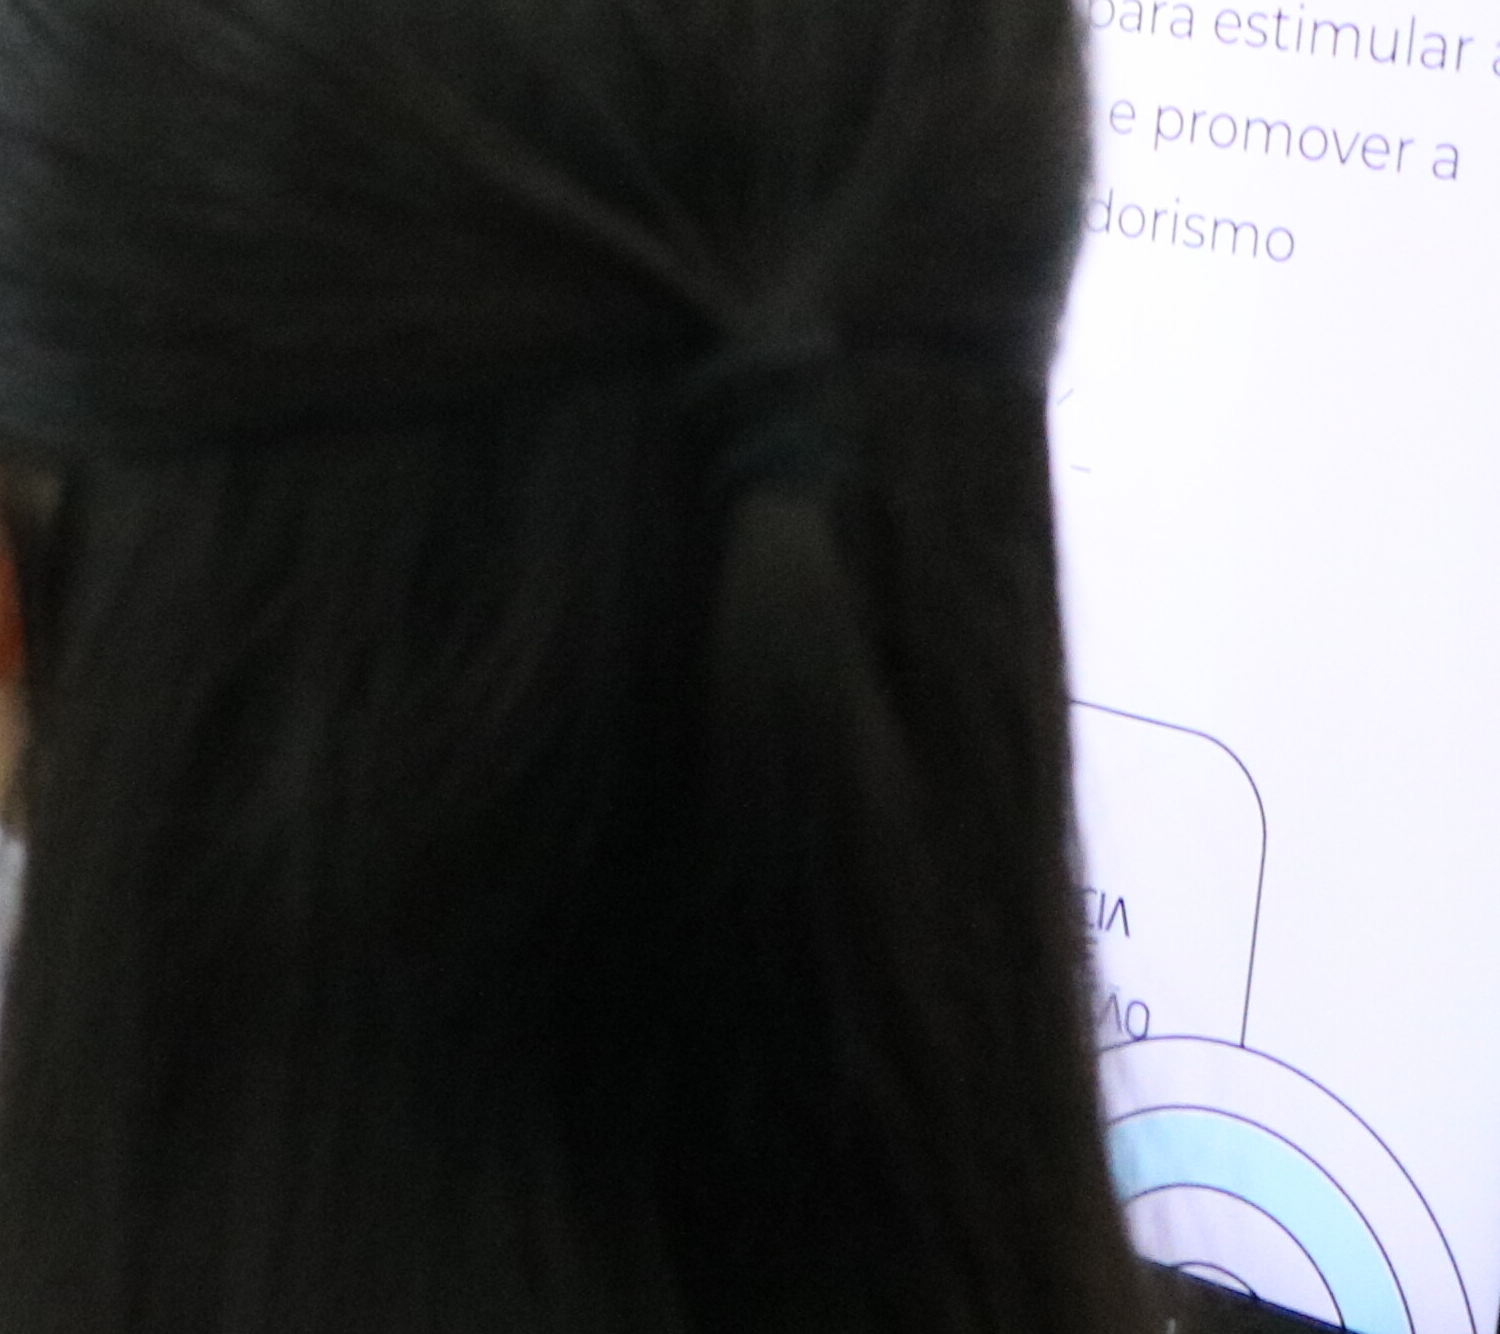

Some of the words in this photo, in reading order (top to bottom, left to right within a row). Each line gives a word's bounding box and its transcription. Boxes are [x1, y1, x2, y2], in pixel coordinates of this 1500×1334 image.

[1214, 3, 1474, 71] estimular
[1109, 100, 1135, 135] e
[1154, 104, 1414, 173] promover
[1432, 143, 1460, 180] a
